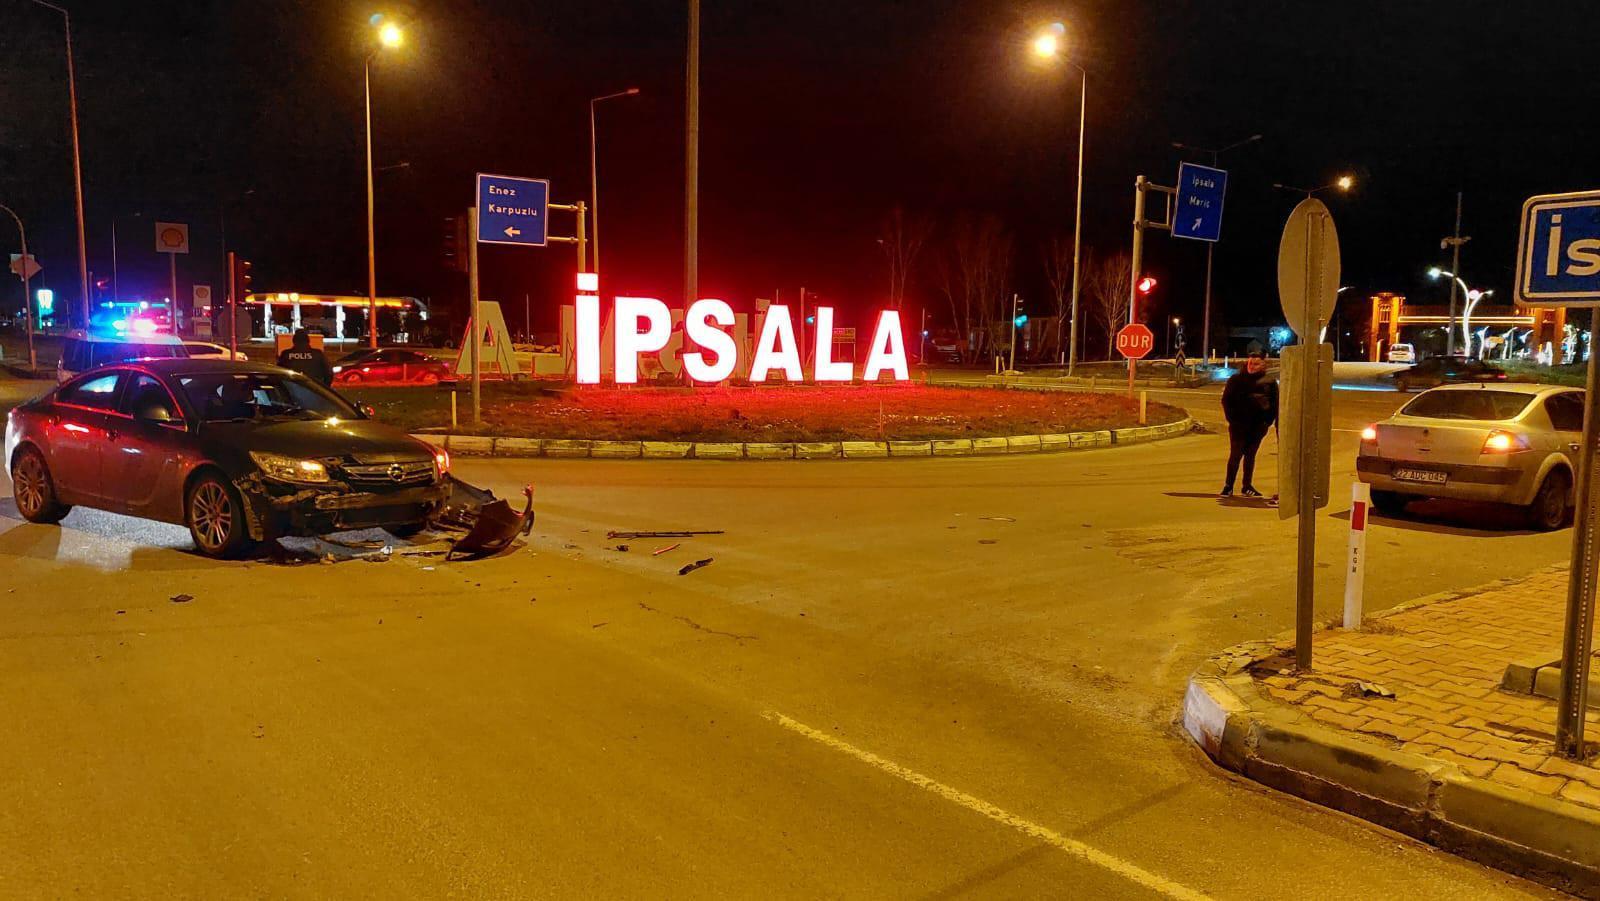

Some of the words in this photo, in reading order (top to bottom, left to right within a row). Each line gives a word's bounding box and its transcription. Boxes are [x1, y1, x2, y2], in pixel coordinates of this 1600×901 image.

[488, 185, 516, 196] Enez
[488, 203, 538, 217] Karpuzlu
[576, 272, 910, 384] İPSALA
[1119, 334, 1151, 349] DUR
